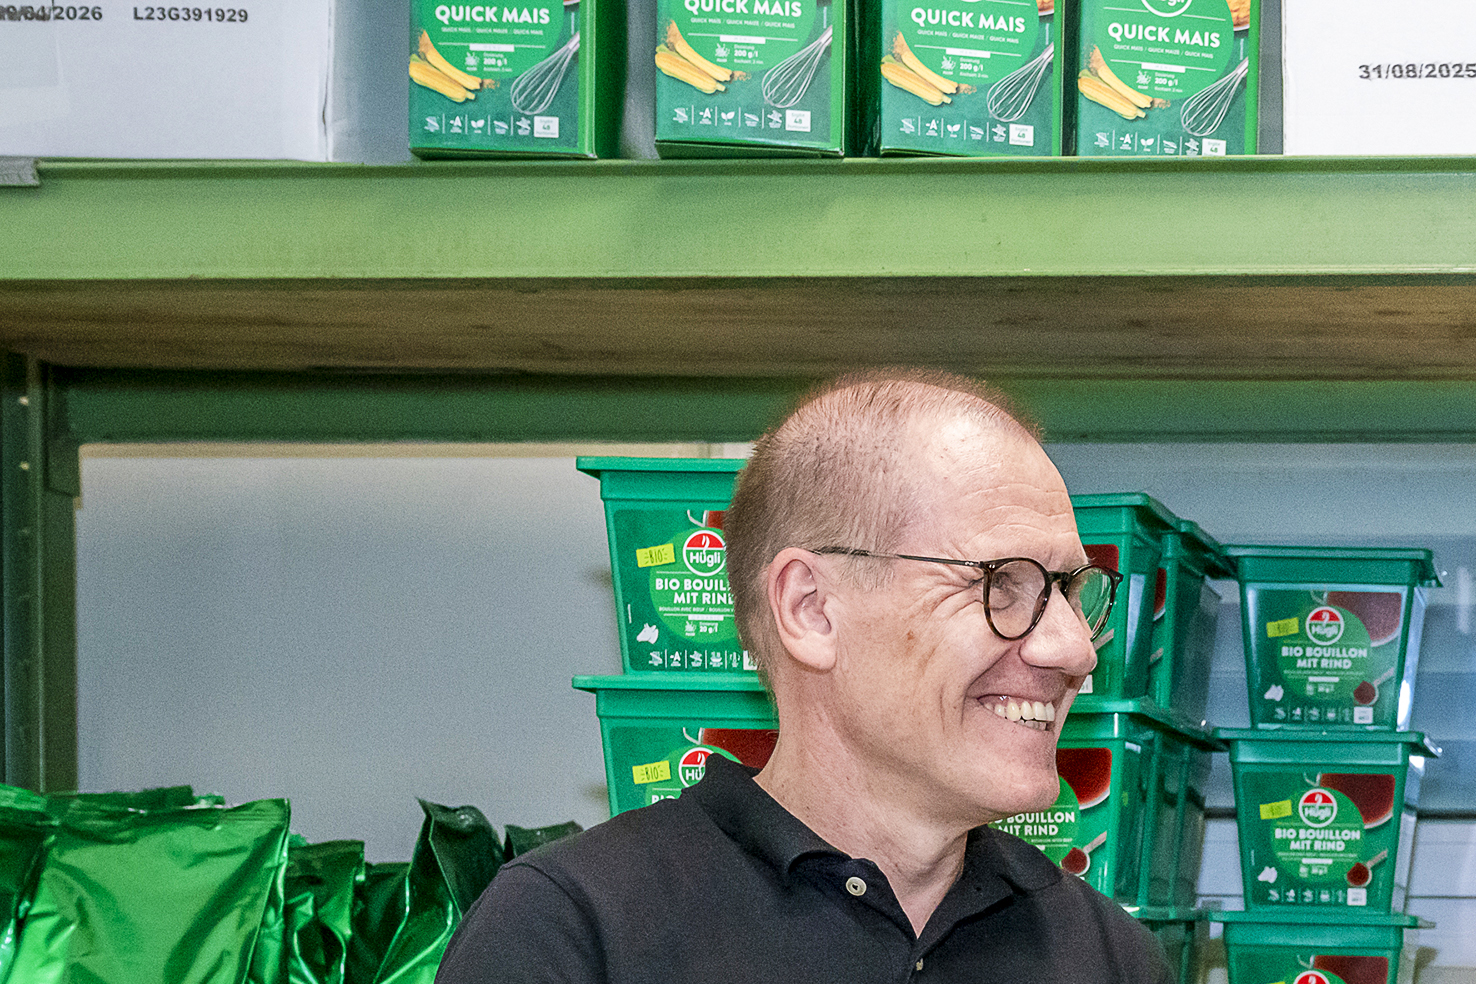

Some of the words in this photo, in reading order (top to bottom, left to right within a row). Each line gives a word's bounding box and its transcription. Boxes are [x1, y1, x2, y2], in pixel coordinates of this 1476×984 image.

[133, 7, 248, 23] L23G391929
[435, 5, 498, 25] QUICK
[502, 7, 550, 24] MAIS
[684, 0, 748, 16] QUICK
[754, 0, 802, 17] MAIS
[911, 8, 974, 27] QUICK
[979, 13, 1025, 33] MAIS
[1108, 22, 1170, 42] QUICK
[1174, 29, 1220, 48] MAIS
[649, 549, 663, 564] BIO
[689, 552, 720, 567] Hügli
[655, 578, 680, 590] BIO
[684, 578, 731, 591] BOUIL
[674, 592, 698, 604] MIT
[1281, 646, 1303, 656] BIO
[1305, 647, 1367, 658] BOUILLON
[1296, 659, 1319, 668] MIT
[1321, 659, 1352, 669] RIND
[1024, 825, 1058, 836] RIND
[1275, 828, 1296, 839] BIO
[1299, 829, 1360, 840] BOUILLON
[1290, 841, 1311, 850] MIT
[1314, 841, 1345, 851] RIND
